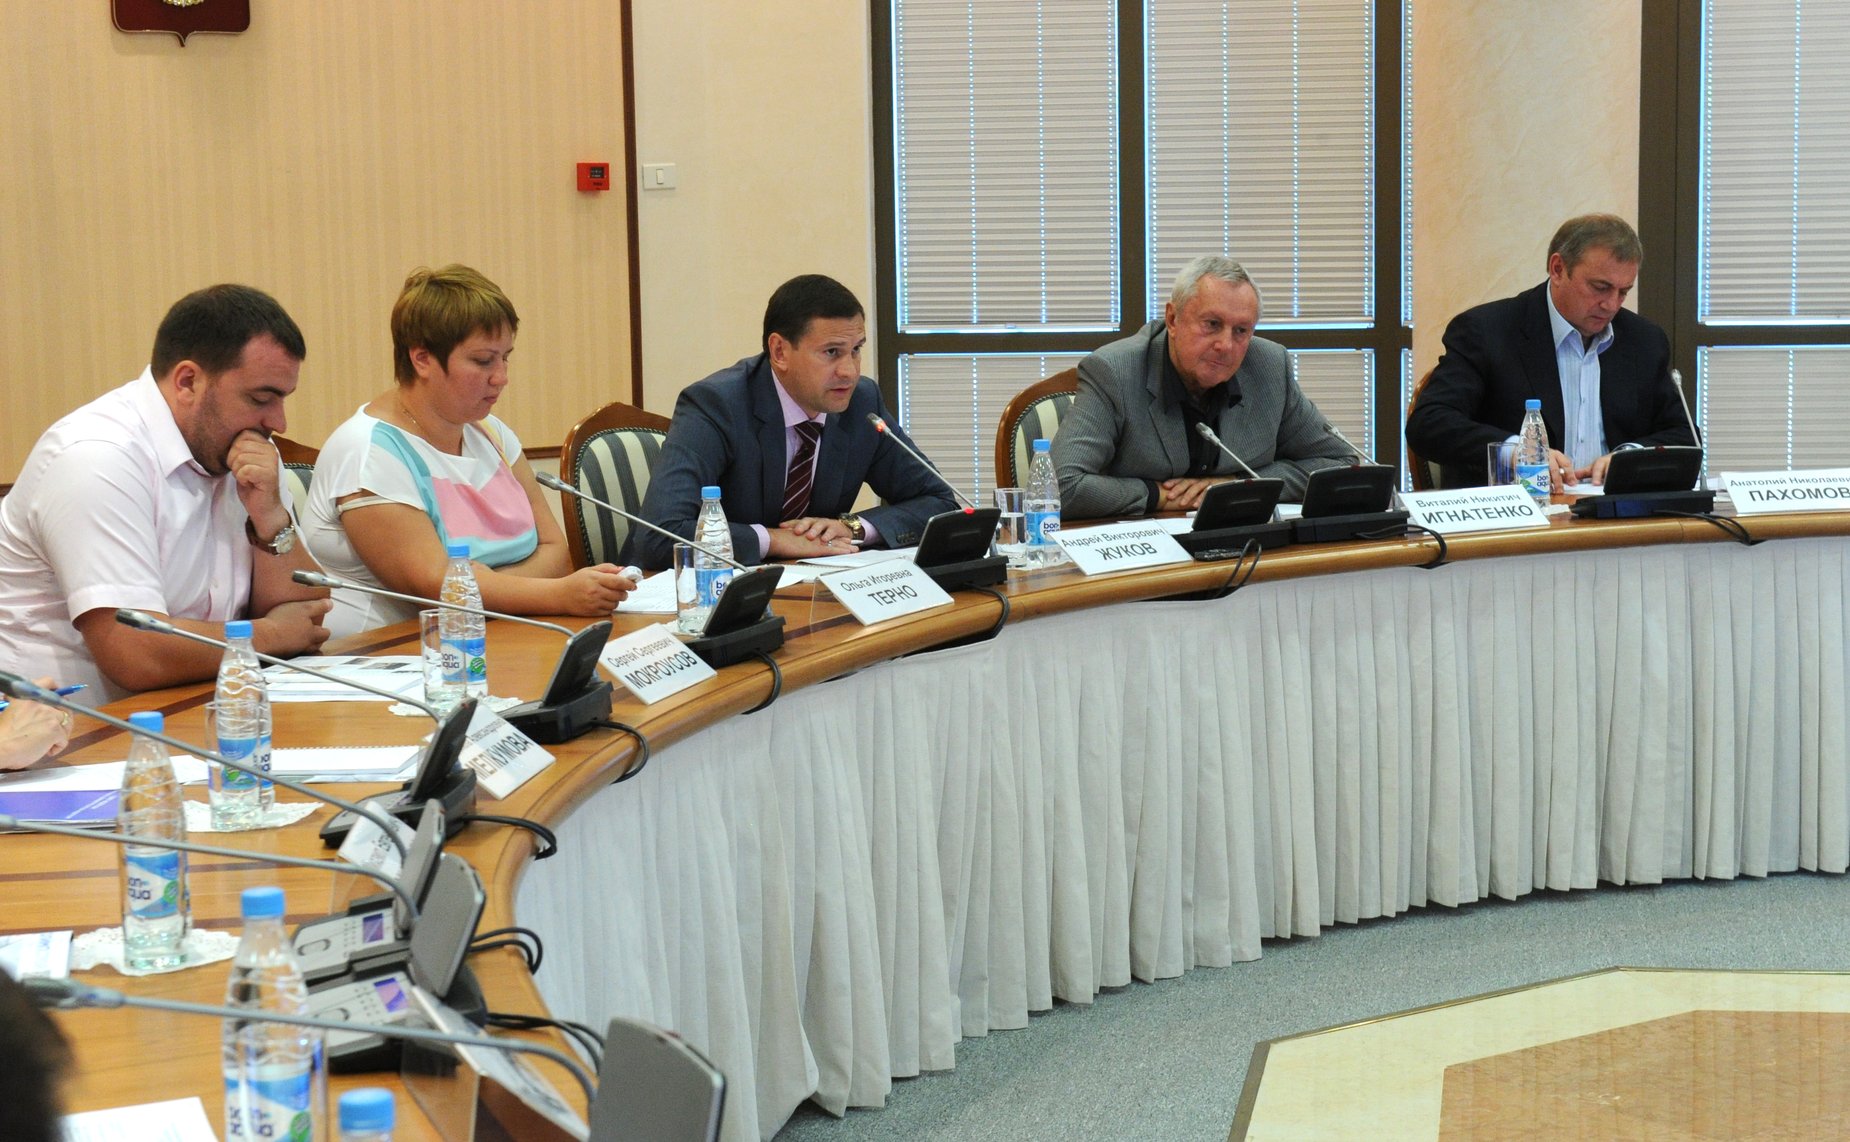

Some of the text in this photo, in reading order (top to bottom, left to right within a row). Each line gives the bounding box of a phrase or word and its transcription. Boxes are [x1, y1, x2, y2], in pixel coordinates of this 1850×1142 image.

[1730, 477, 1787, 487] Анатолий
[1415, 493, 1521, 508] Виталий Никитич
[1748, 487, 1850, 501] ПАХОМОВ
[1421, 504, 1534, 524] ИГНАТЕНКО
[1061, 528, 1165, 548] Андрей Викторович
[1094, 543, 1158, 561] ЖУКОВ
[840, 568, 913, 592] Ольга Игоревна
[867, 584, 918, 606] ТЕРНО
[624, 650, 698, 690] МОКРОУСОВ
